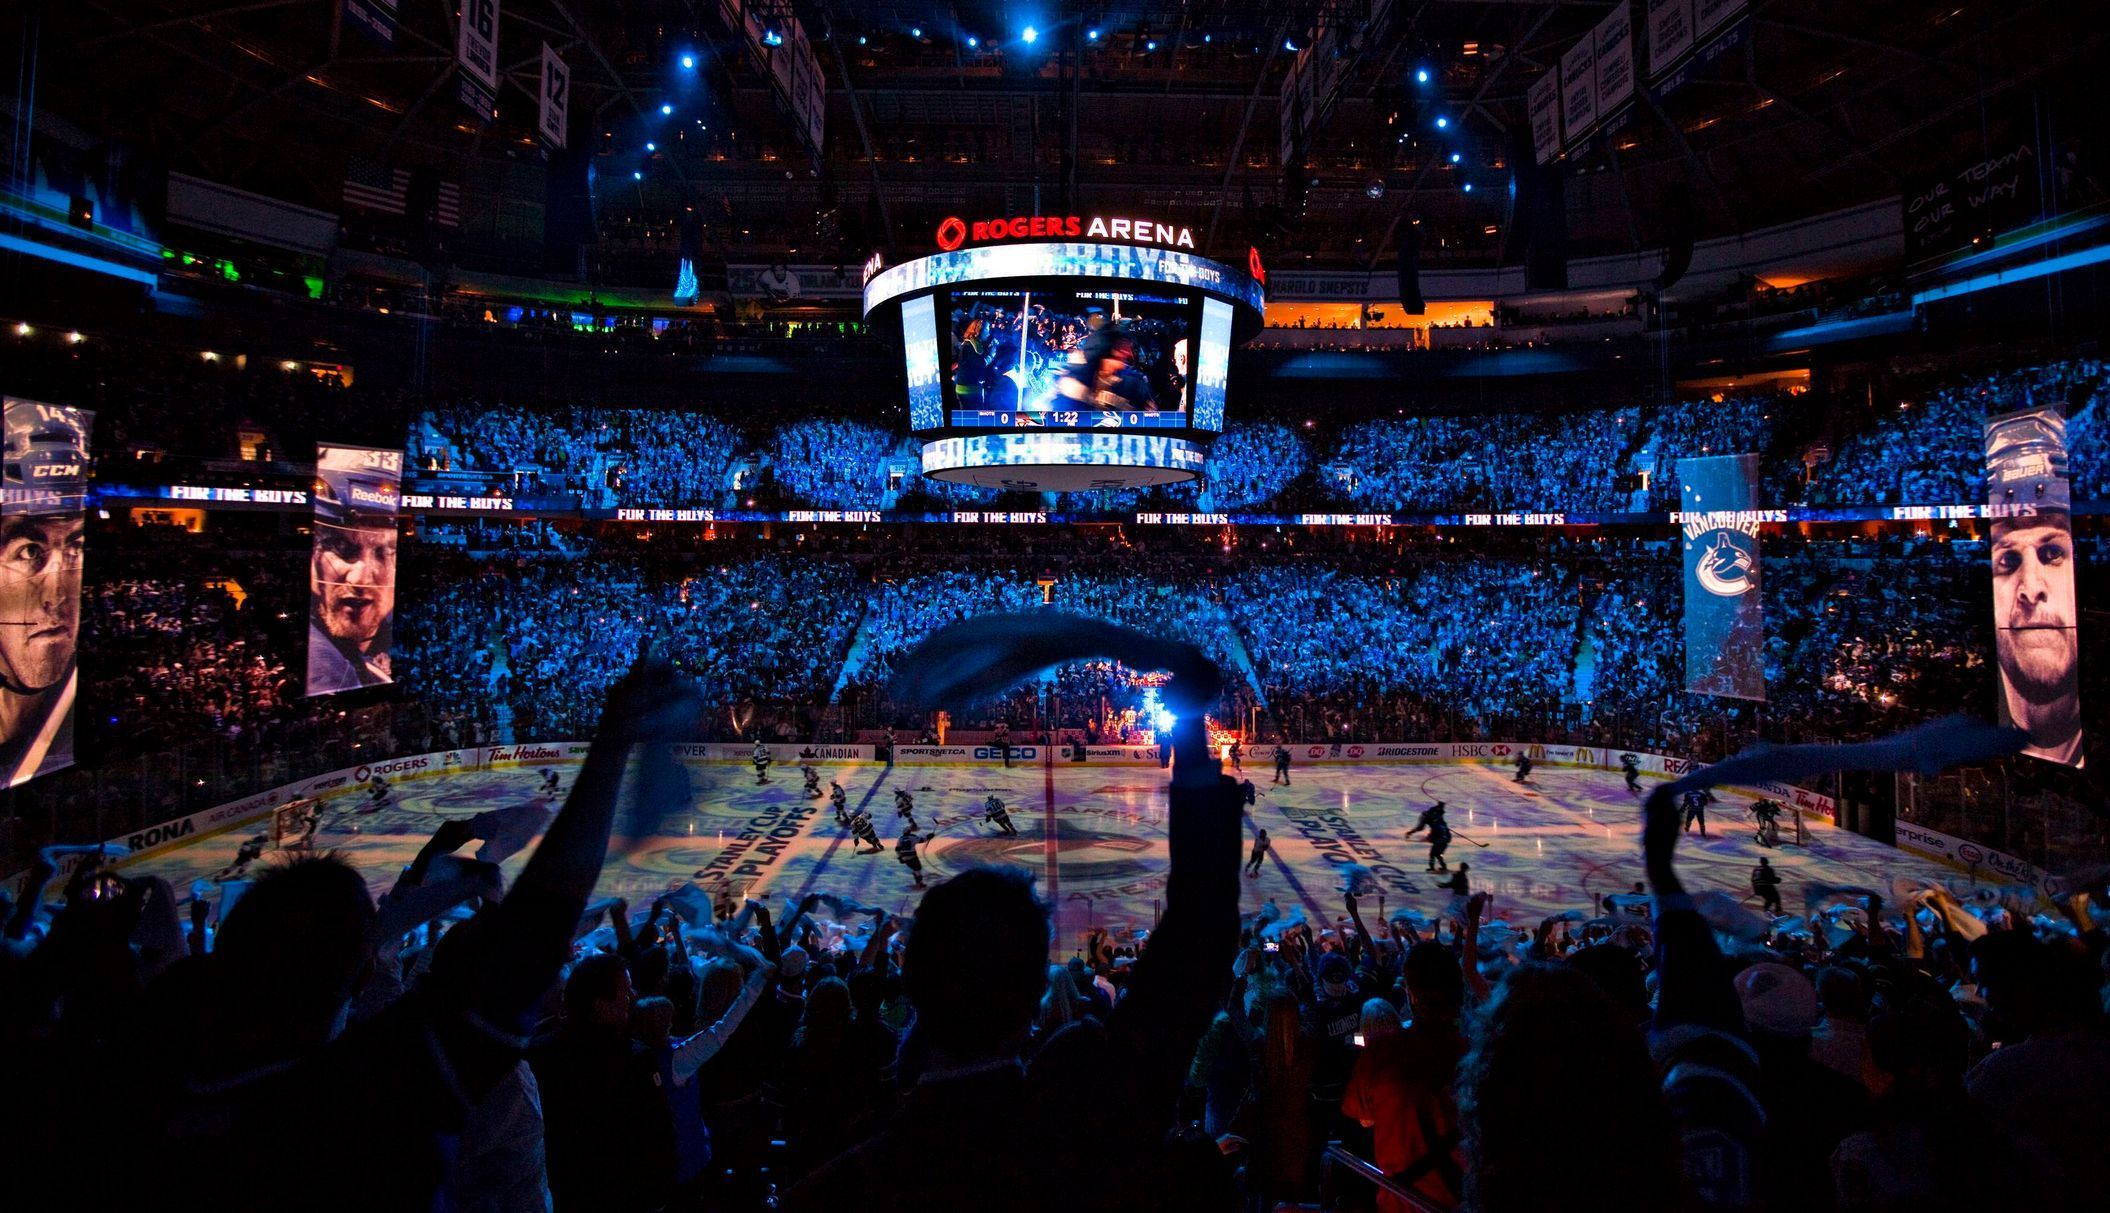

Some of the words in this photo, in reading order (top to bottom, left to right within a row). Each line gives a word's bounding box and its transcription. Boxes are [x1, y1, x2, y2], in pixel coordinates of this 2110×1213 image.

[548, 61, 565, 110] 12
[1907, 182, 1949, 214] OUR
[1955, 145, 2034, 184] TEAM
[1912, 202, 1955, 233] OUR
[1967, 174, 2019, 208] WAY
[972, 217, 1080, 240] ROGERS
[1086, 217, 1195, 248] ARENA
[1198, 267, 1221, 284] BOYS
[1001, 414, 1008, 424] 0
[1052, 411, 1079, 423] 1:22
[1130, 415, 1138, 425] 0
[365, 450, 399, 470] 33
[33, 464, 79, 478] CCM
[172, 486, 211, 501] FOR
[214, 488, 254, 502] THE
[258, 489, 307, 504] BOYS
[352, 487, 398, 508] Reebok
[401, 495, 434, 508] FOR
[437, 496, 467, 509] THE
[469, 497, 513, 510] BOYS
[617, 509, 645, 521] FOR
[648, 509, 674, 521] THE
[677, 509, 714, 521] BOYS
[789, 510, 816, 522] FOR
[817, 511, 842, 522] THE
[845, 511, 881, 522] BOYS
[953, 511, 979, 523] FOR
[983, 512, 1006, 523] THE
[1010, 512, 1046, 524] BOYS
[1136, 513, 1162, 525] FOR
[1166, 513, 1190, 525] THE
[1193, 513, 1228, 525] BOYS
[1302, 514, 1327, 525] FOR
[1329, 514, 1354, 525] THE
[1356, 514, 1391, 525] BOYS
[1465, 514, 1492, 526] FOR
[1496, 514, 1521, 526] THE
[1524, 514, 1564, 526] BOYS
[1893, 506, 1935, 520] FOR
[1938, 505, 1977, 519] THE
[1981, 503, 2037, 518] BOYS
[1683, 513, 1760, 541] VANCOUVER
[488, 747, 512, 762] Tim
[513, 745, 560, 760] Hortons
[814, 748, 859, 759] CANADIAN
[974, 747, 1036, 760] GECO
[1146, 748, 1161, 760] Su
[1377, 747, 1438, 756] BRIDGESTONE
[1452, 745, 1488, 757] HSBC
[374, 758, 428, 775] ROGERS
[1755, 782, 1790, 798] ONDA
[1795, 789, 1816, 811] Tim
[207, 812, 225, 824] AIR
[226, 798, 268, 819] CANADA
[128, 818, 196, 851] RONA
[733, 806, 818, 878] PLAYOFFS
[1317, 816, 1390, 864] STANLEY
[693, 827, 766, 882] STANLEY
[750, 806, 784, 828] CUP
[1067, 878, 1168, 902] AREN
